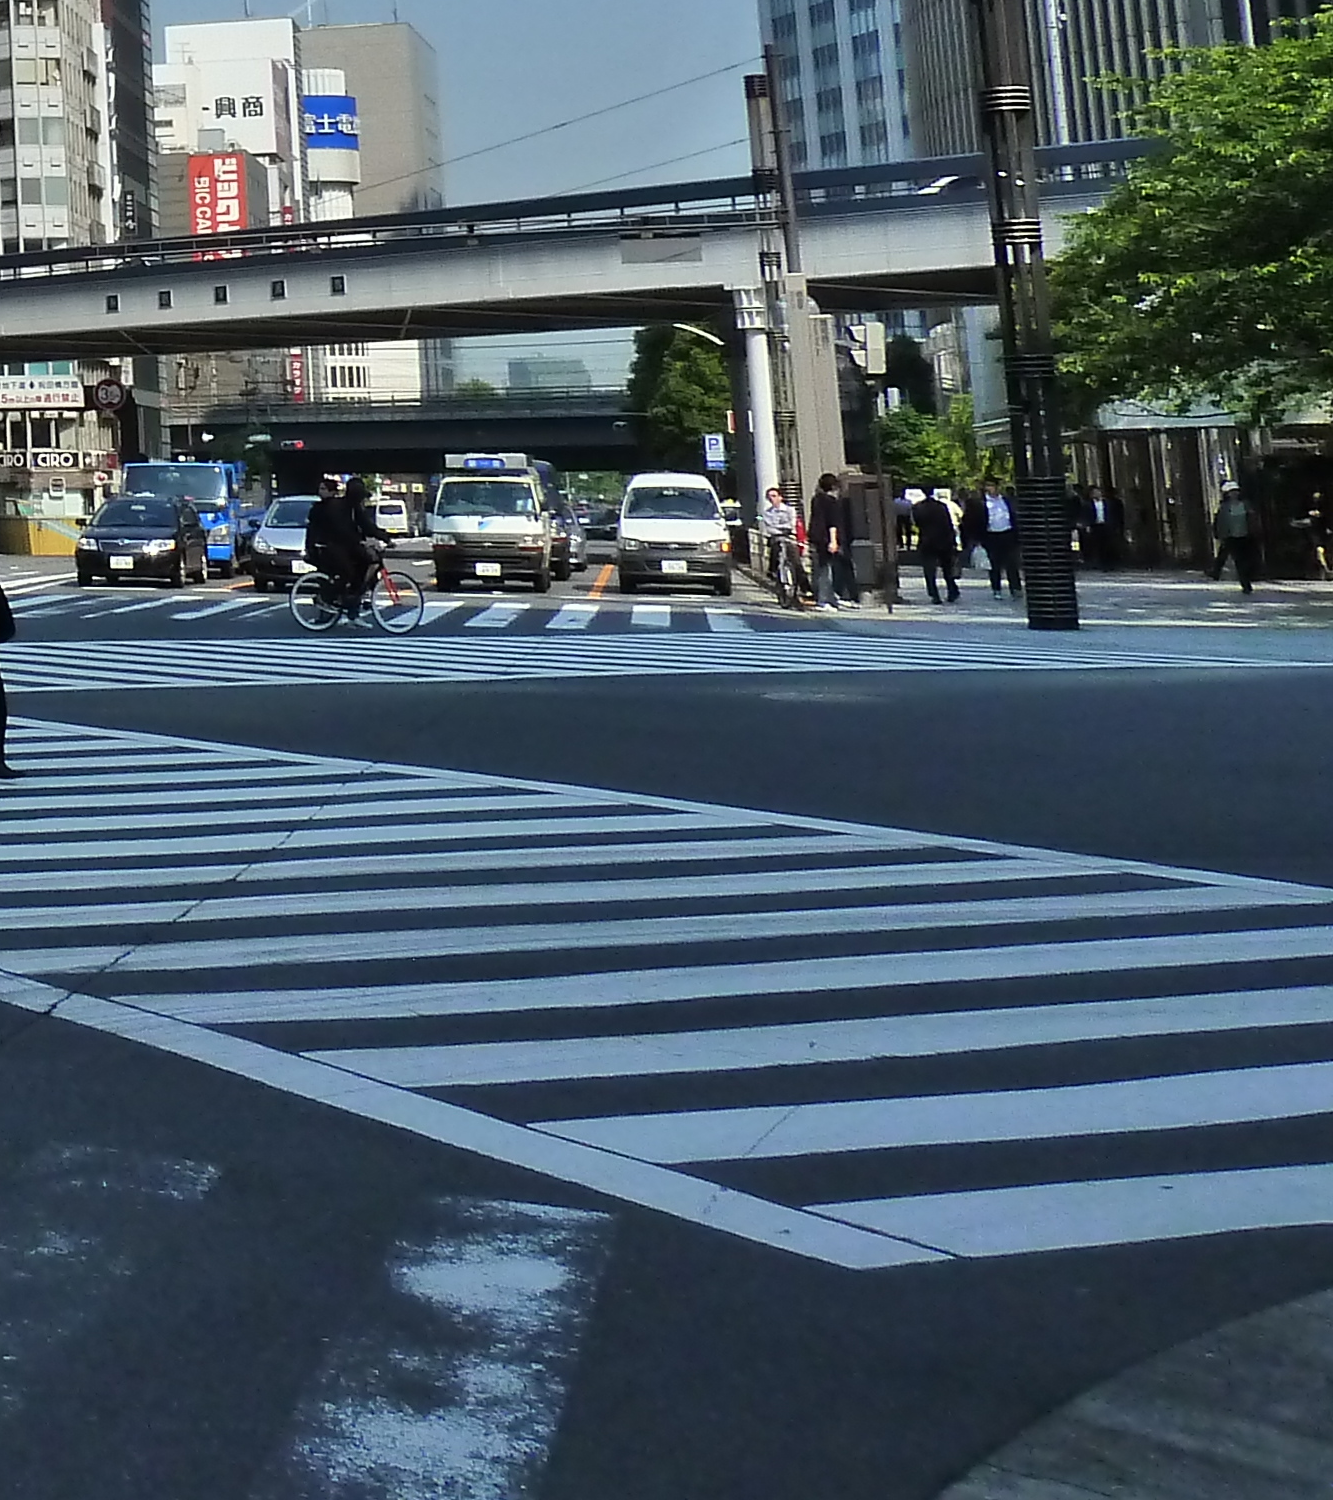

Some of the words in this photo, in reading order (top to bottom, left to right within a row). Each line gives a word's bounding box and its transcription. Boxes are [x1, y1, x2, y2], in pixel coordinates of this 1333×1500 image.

[303, 113, 361, 134] 富士電
[194, 177, 211, 205] BIC
[707, 437, 720, 451] P
[36, 452, 74, 468] CIRO
